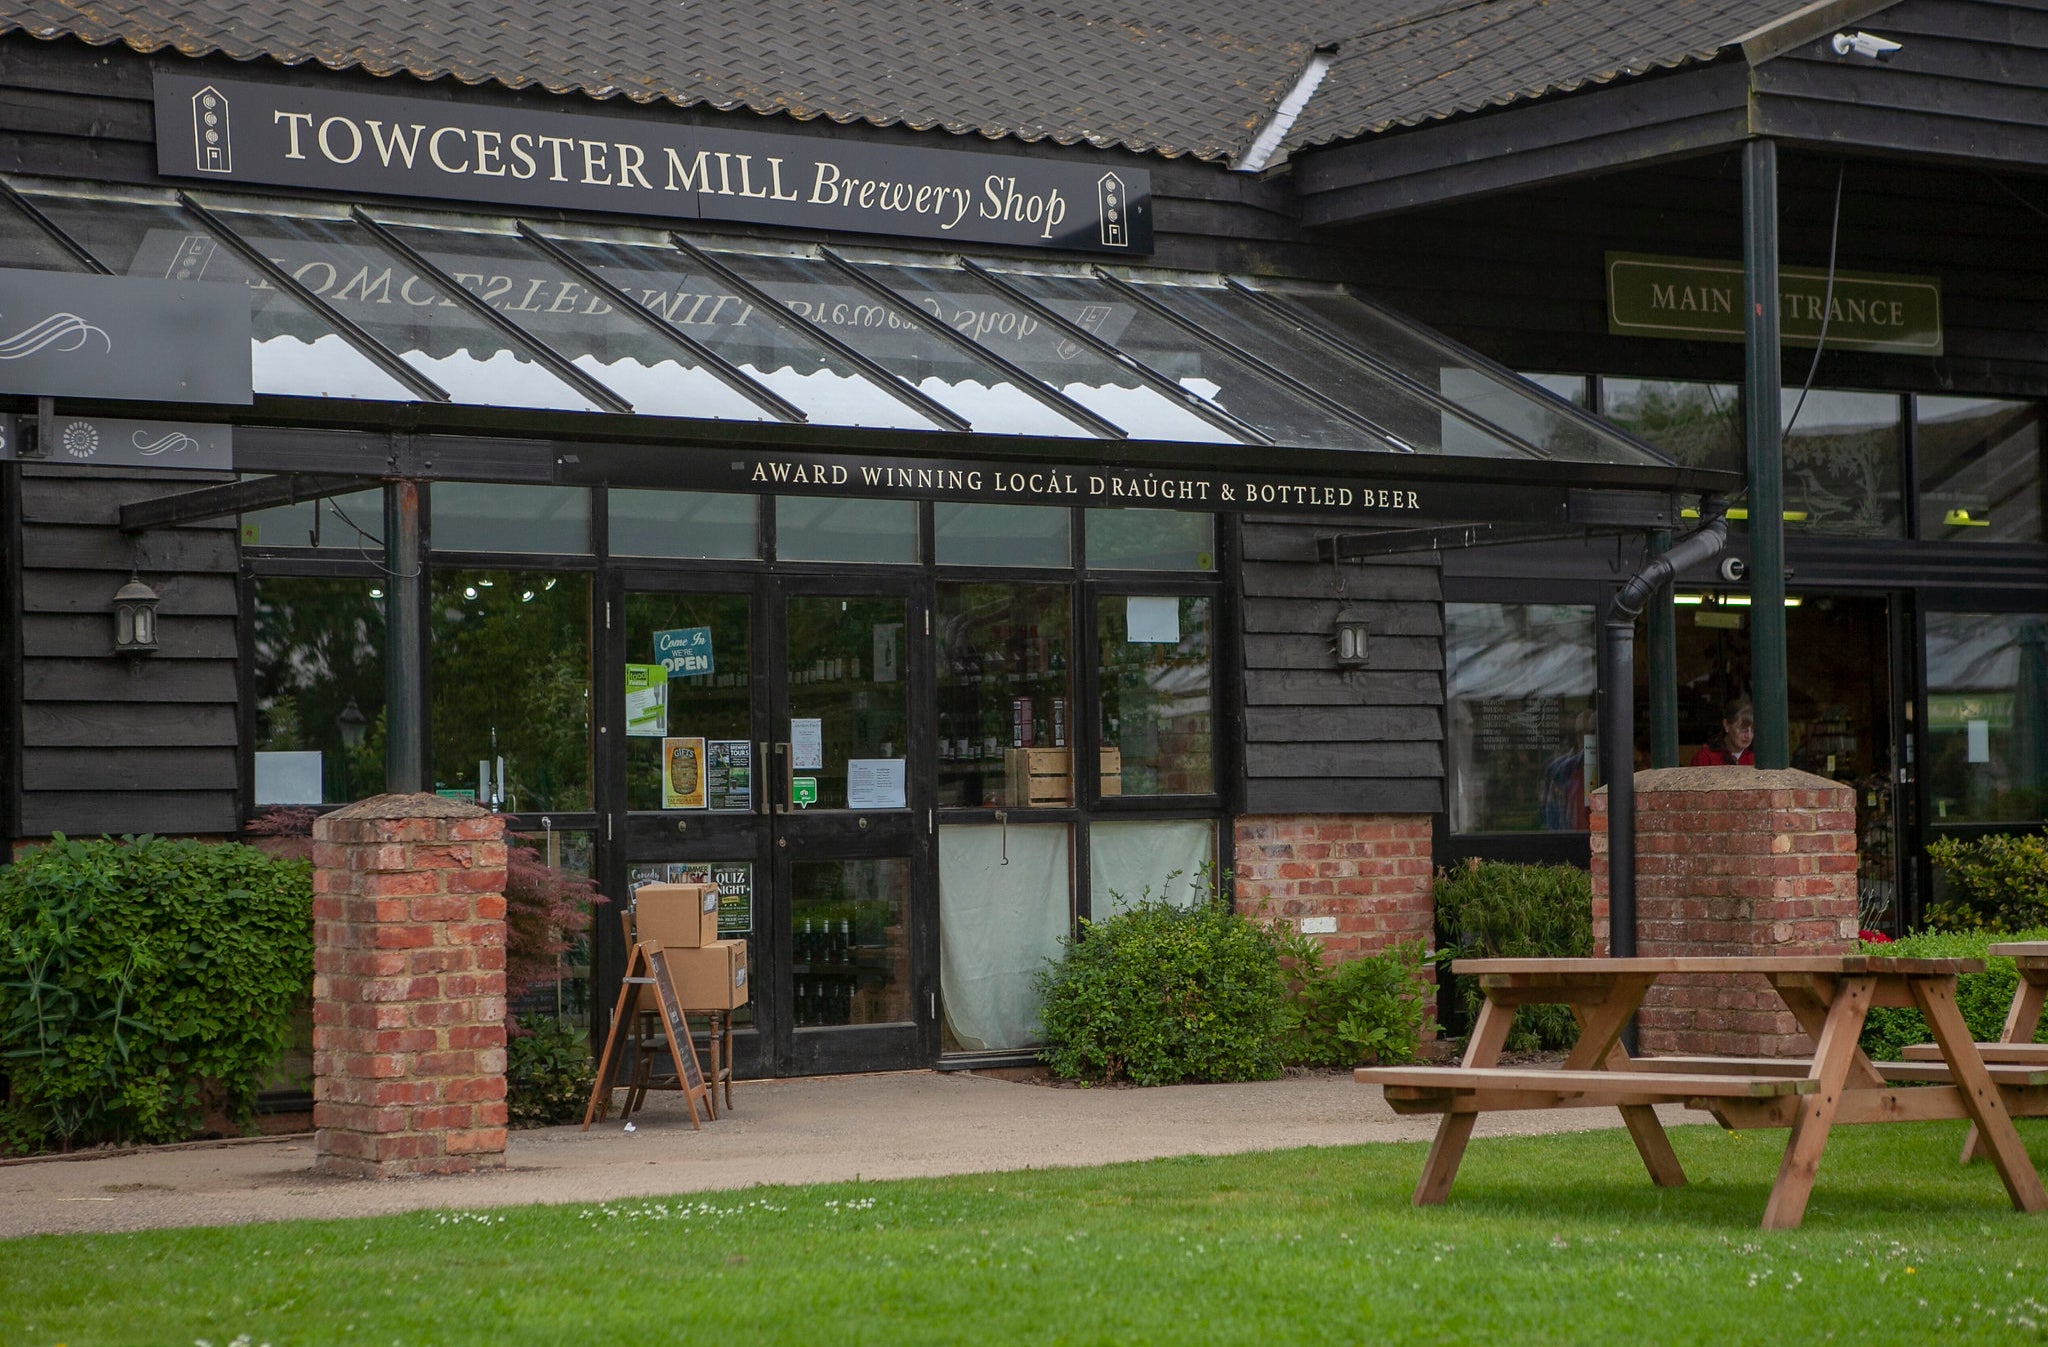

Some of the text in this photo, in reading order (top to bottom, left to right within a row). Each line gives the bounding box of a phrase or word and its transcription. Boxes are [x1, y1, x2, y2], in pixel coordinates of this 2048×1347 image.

[274, 110, 1067, 239] TOWCESTER MILL Brewery Shop
[1651, 284, 1906, 327] MAIN TRANCE
[751, 462, 1420, 509] AWARD WINNING LOCAL DRAUGHT & BOTTLED BEER
[660, 632, 706, 651] Come In
[671, 648, 694, 657] WE'RE
[661, 656, 708, 672] OPEN
[673, 748, 695, 758] GIFTS
[715, 872, 746, 885] QUIZ
